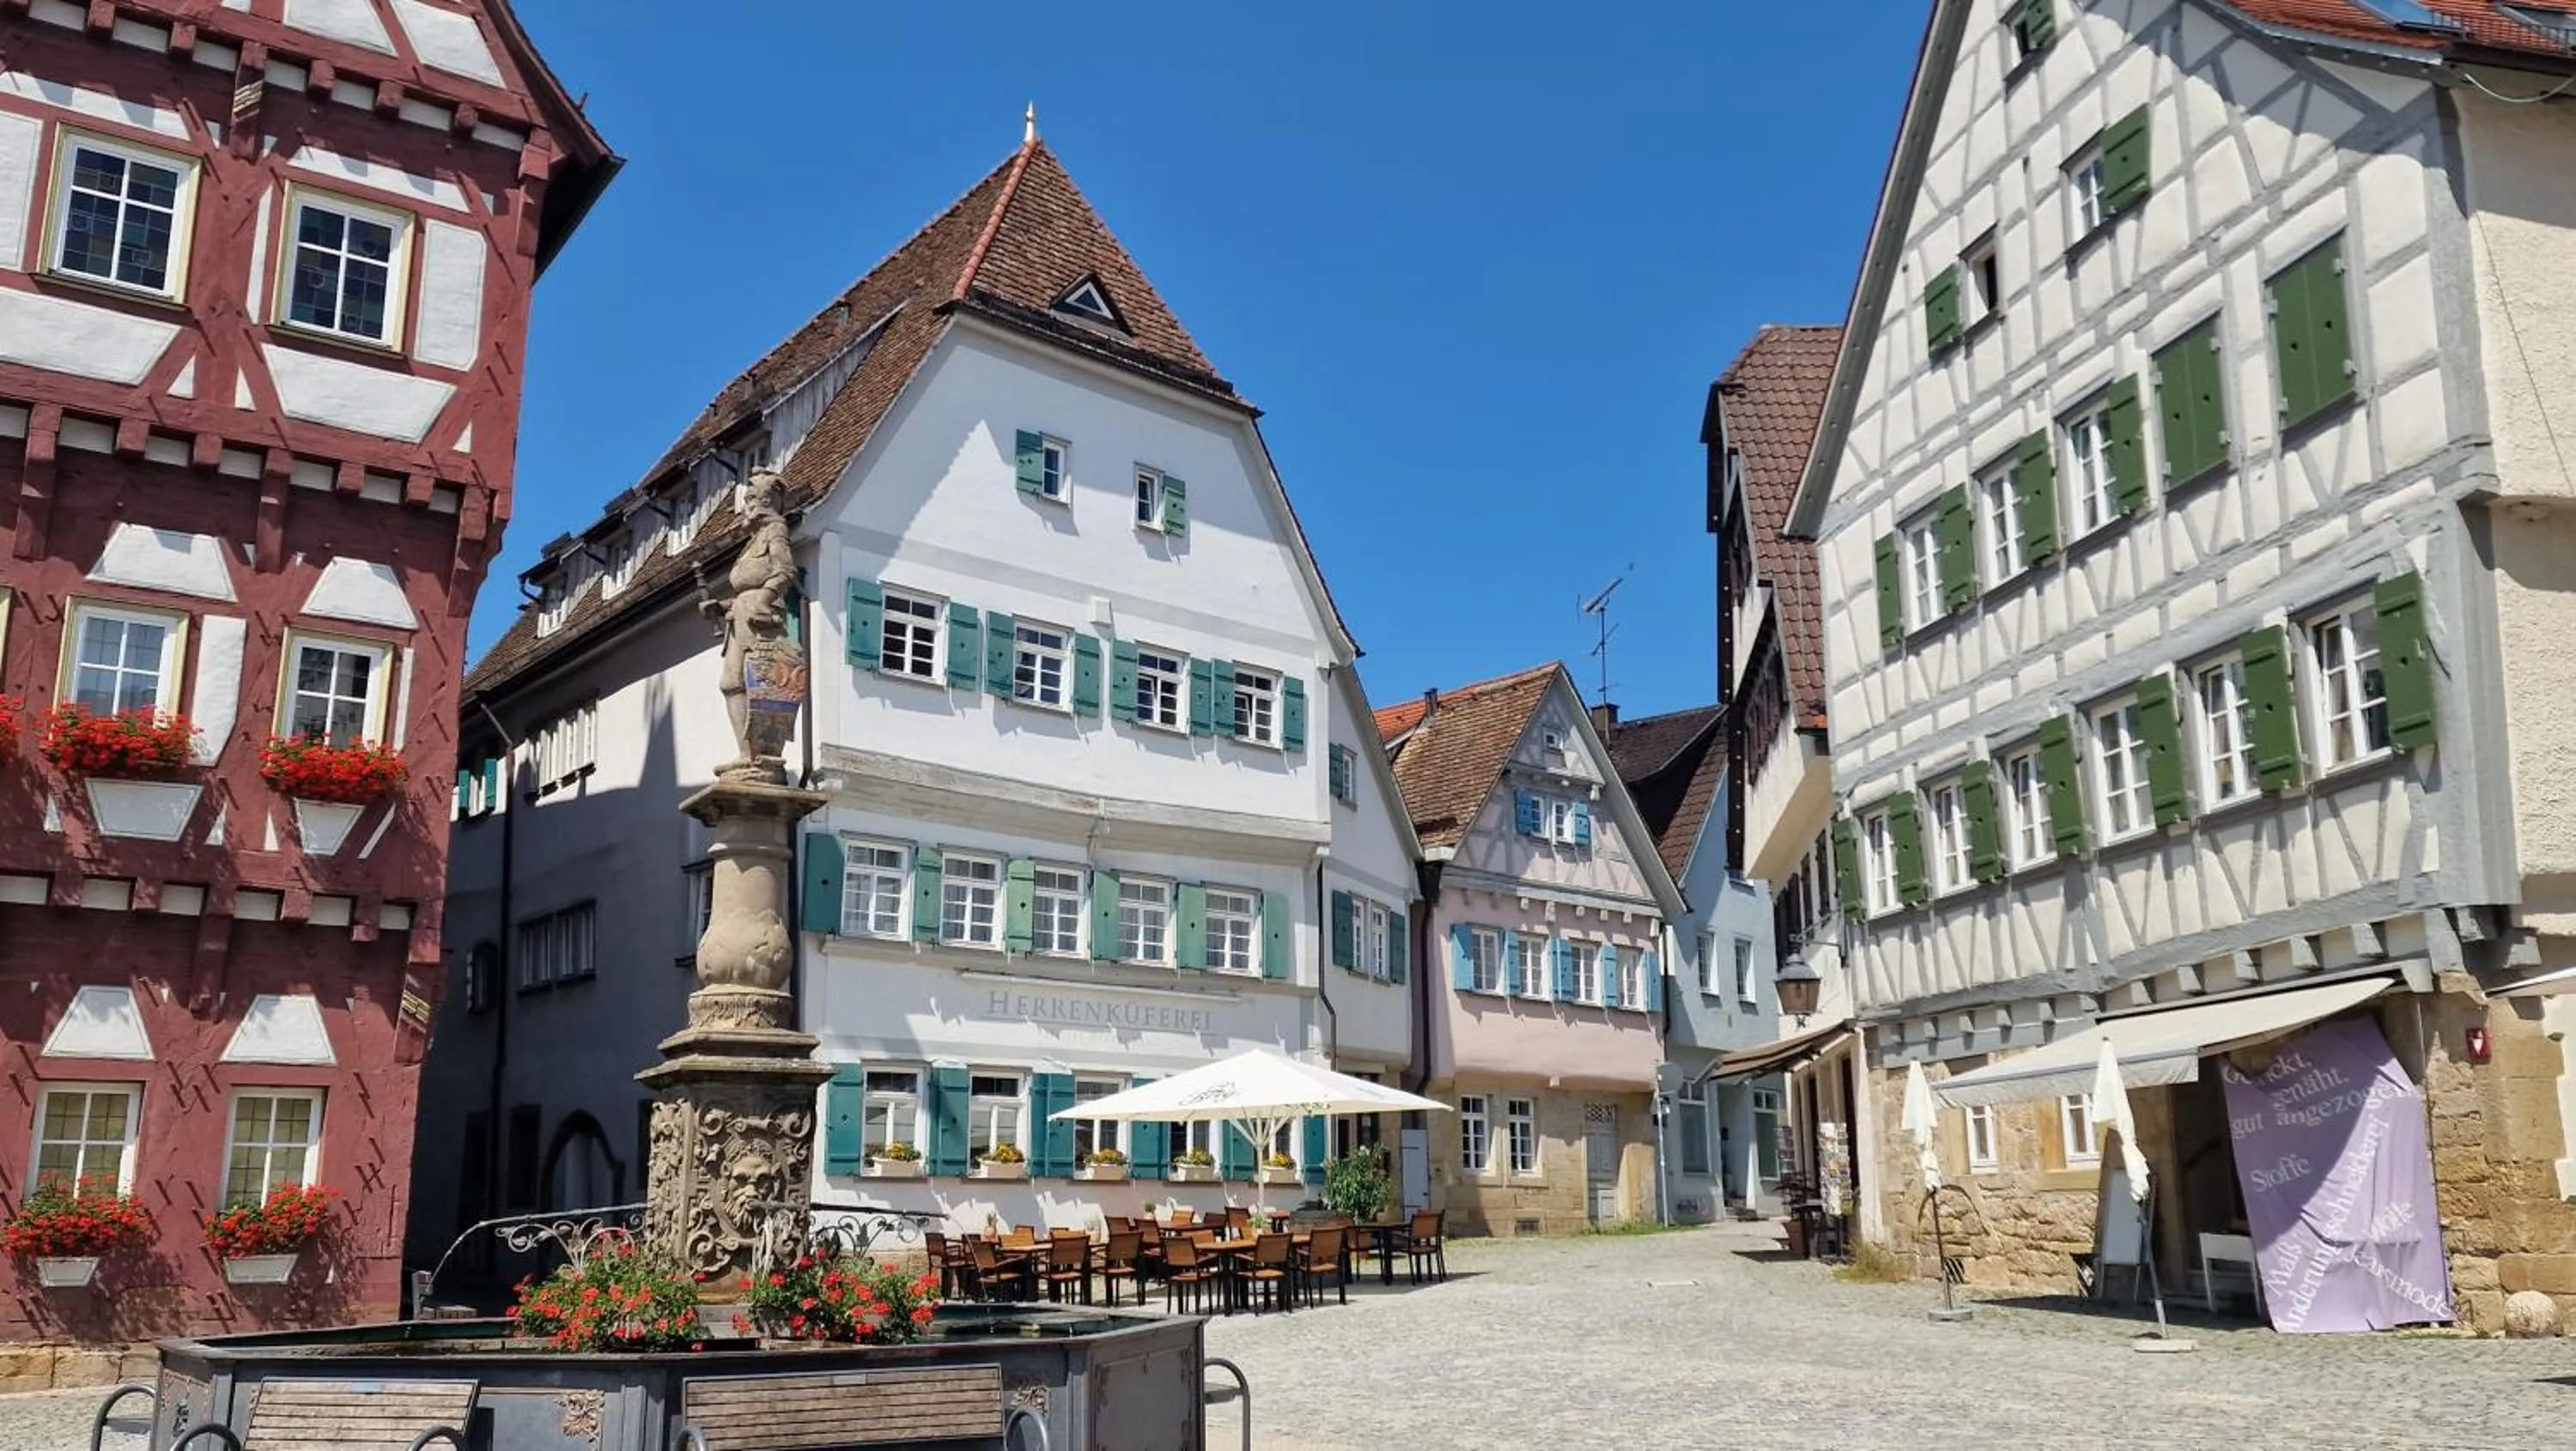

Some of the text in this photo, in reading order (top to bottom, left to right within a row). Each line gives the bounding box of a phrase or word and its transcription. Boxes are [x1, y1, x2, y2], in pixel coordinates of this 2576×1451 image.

[988, 990, 1212, 1031] HERRENKÜFEREI
[2231, 1111, 2263, 1139] gut
[2250, 1153, 2312, 1193] Stoffe
